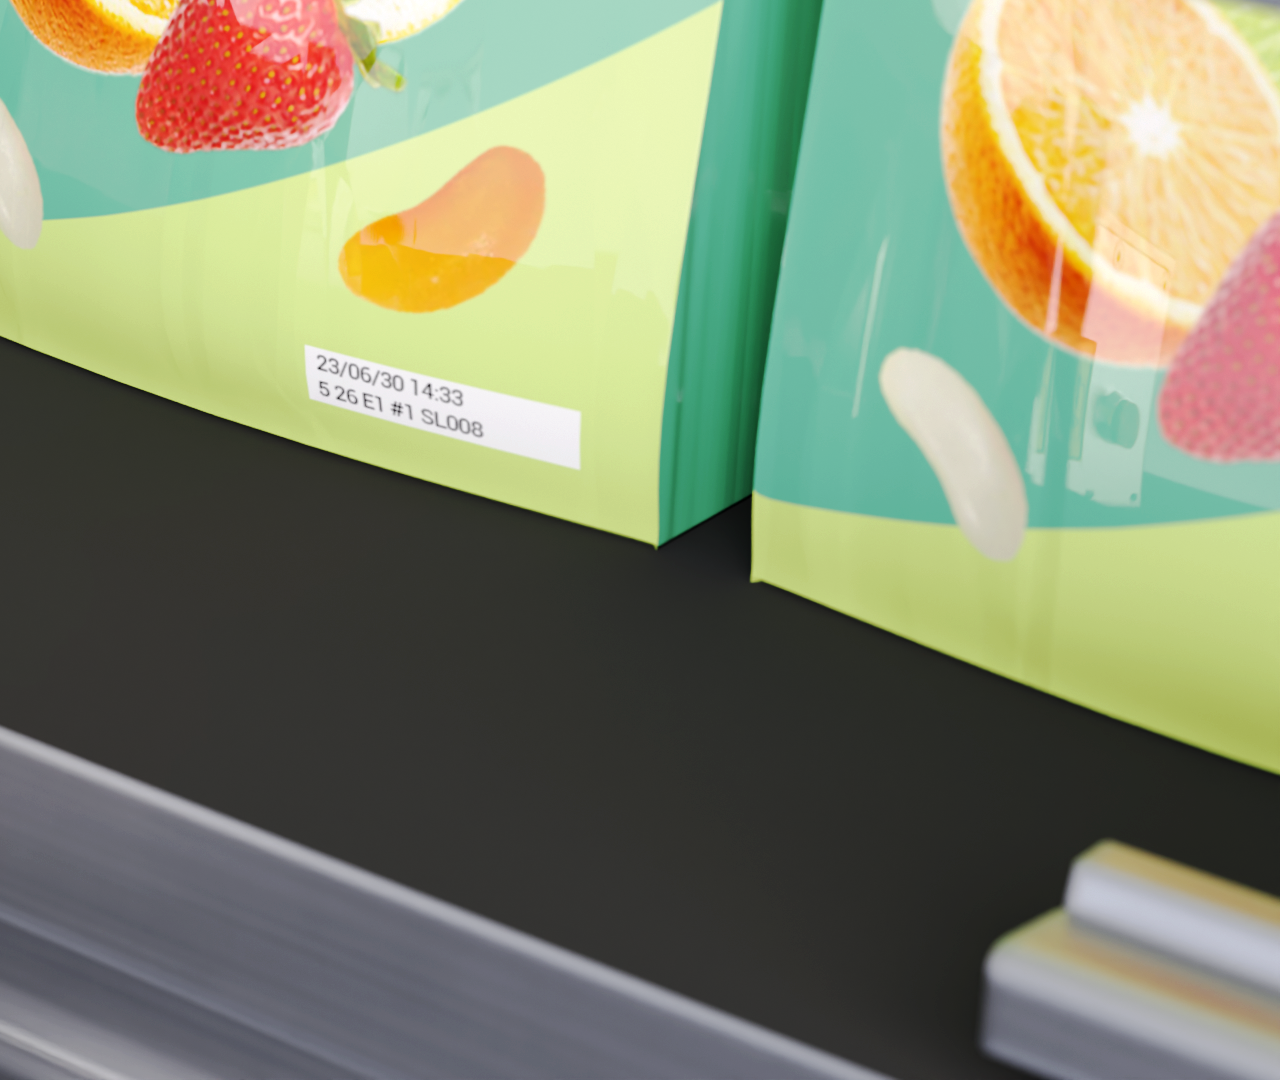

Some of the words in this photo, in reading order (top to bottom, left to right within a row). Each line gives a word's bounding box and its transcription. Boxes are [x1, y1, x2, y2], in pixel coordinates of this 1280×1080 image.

[317, 355, 404, 392] 23/06/30
[411, 378, 464, 406] 14:33
[318, 381, 330, 397] 5
[334, 386, 358, 405] 26
[362, 392, 383, 412] E1
[390, 401, 413, 420] #1
[421, 408, 484, 438] SL008
